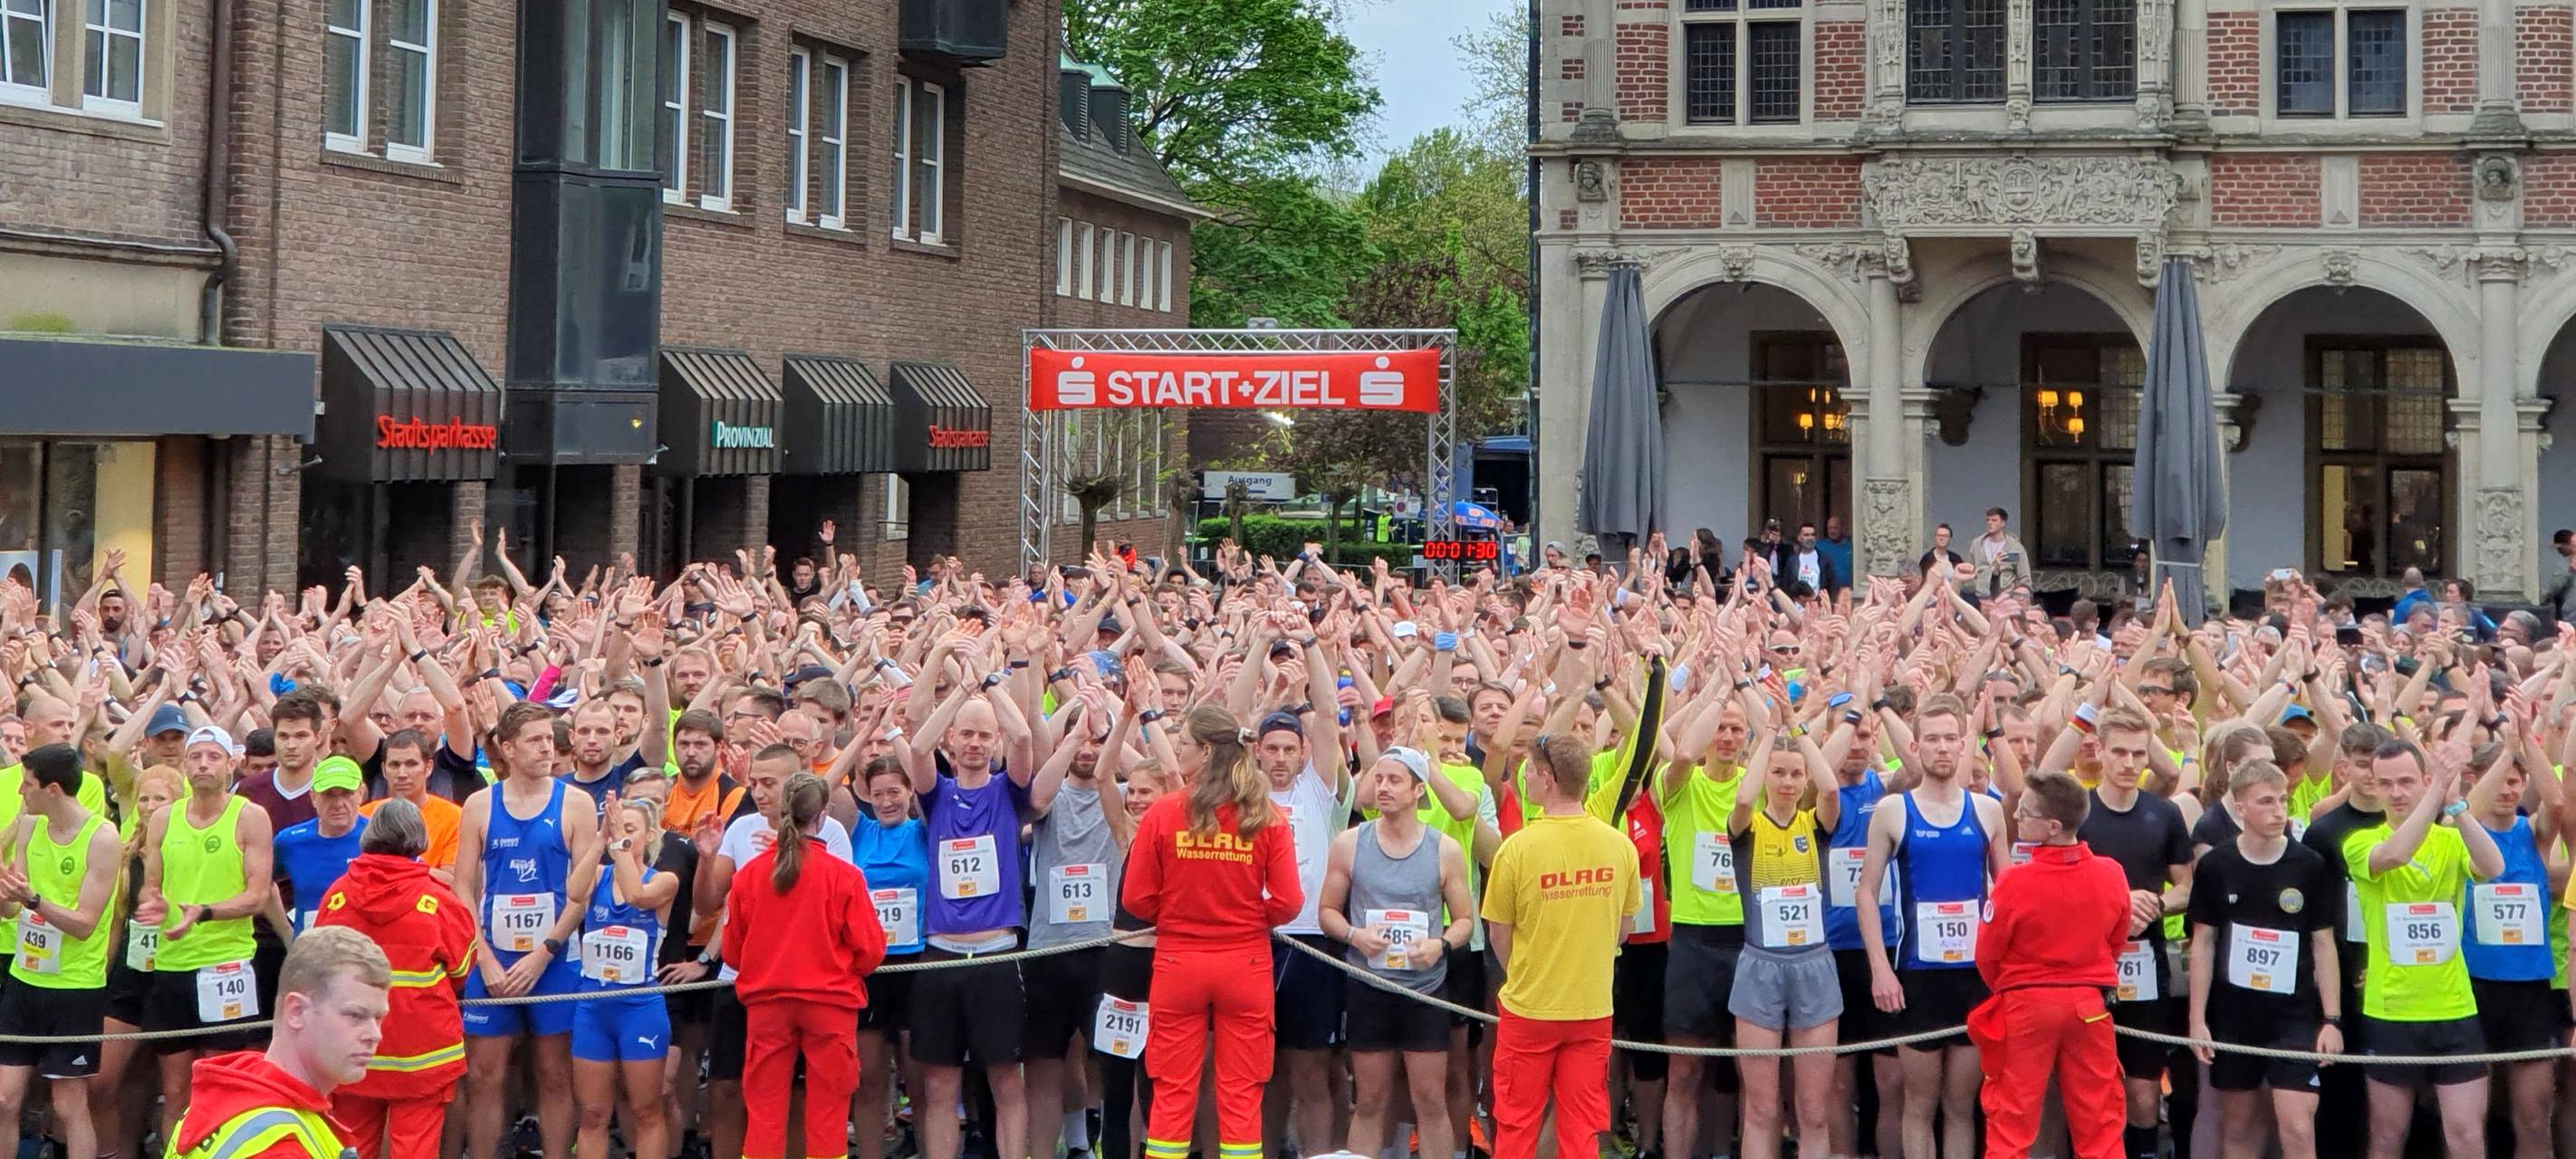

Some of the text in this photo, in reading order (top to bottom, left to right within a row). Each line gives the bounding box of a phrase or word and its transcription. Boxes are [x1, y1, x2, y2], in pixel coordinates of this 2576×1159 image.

[1108, 370, 1346, 405] START+ZIEL
[376, 415, 496, 455] Stadtsparkasse
[951, 857, 982, 875] 612
[1177, 848, 1254, 866] Wasserrettung
[1711, 851, 1732, 868] 76
[1540, 867, 1616, 890] DLRG
[1062, 882, 1092, 899] 613
[504, 913, 544, 929] 1167
[1779, 905, 1810, 922] 521
[2494, 904, 2527, 920] 577
[1937, 922, 1968, 938] 150
[2408, 923, 2442, 940] 856
[24, 930, 46, 949] 439
[140, 934, 159, 949] 41
[594, 943, 634, 962] 1166
[2246, 947, 2281, 966] 897
[2116, 961, 2141, 977] 761
[216, 979, 245, 997] 140
[1105, 1014, 1141, 1035] 2191
